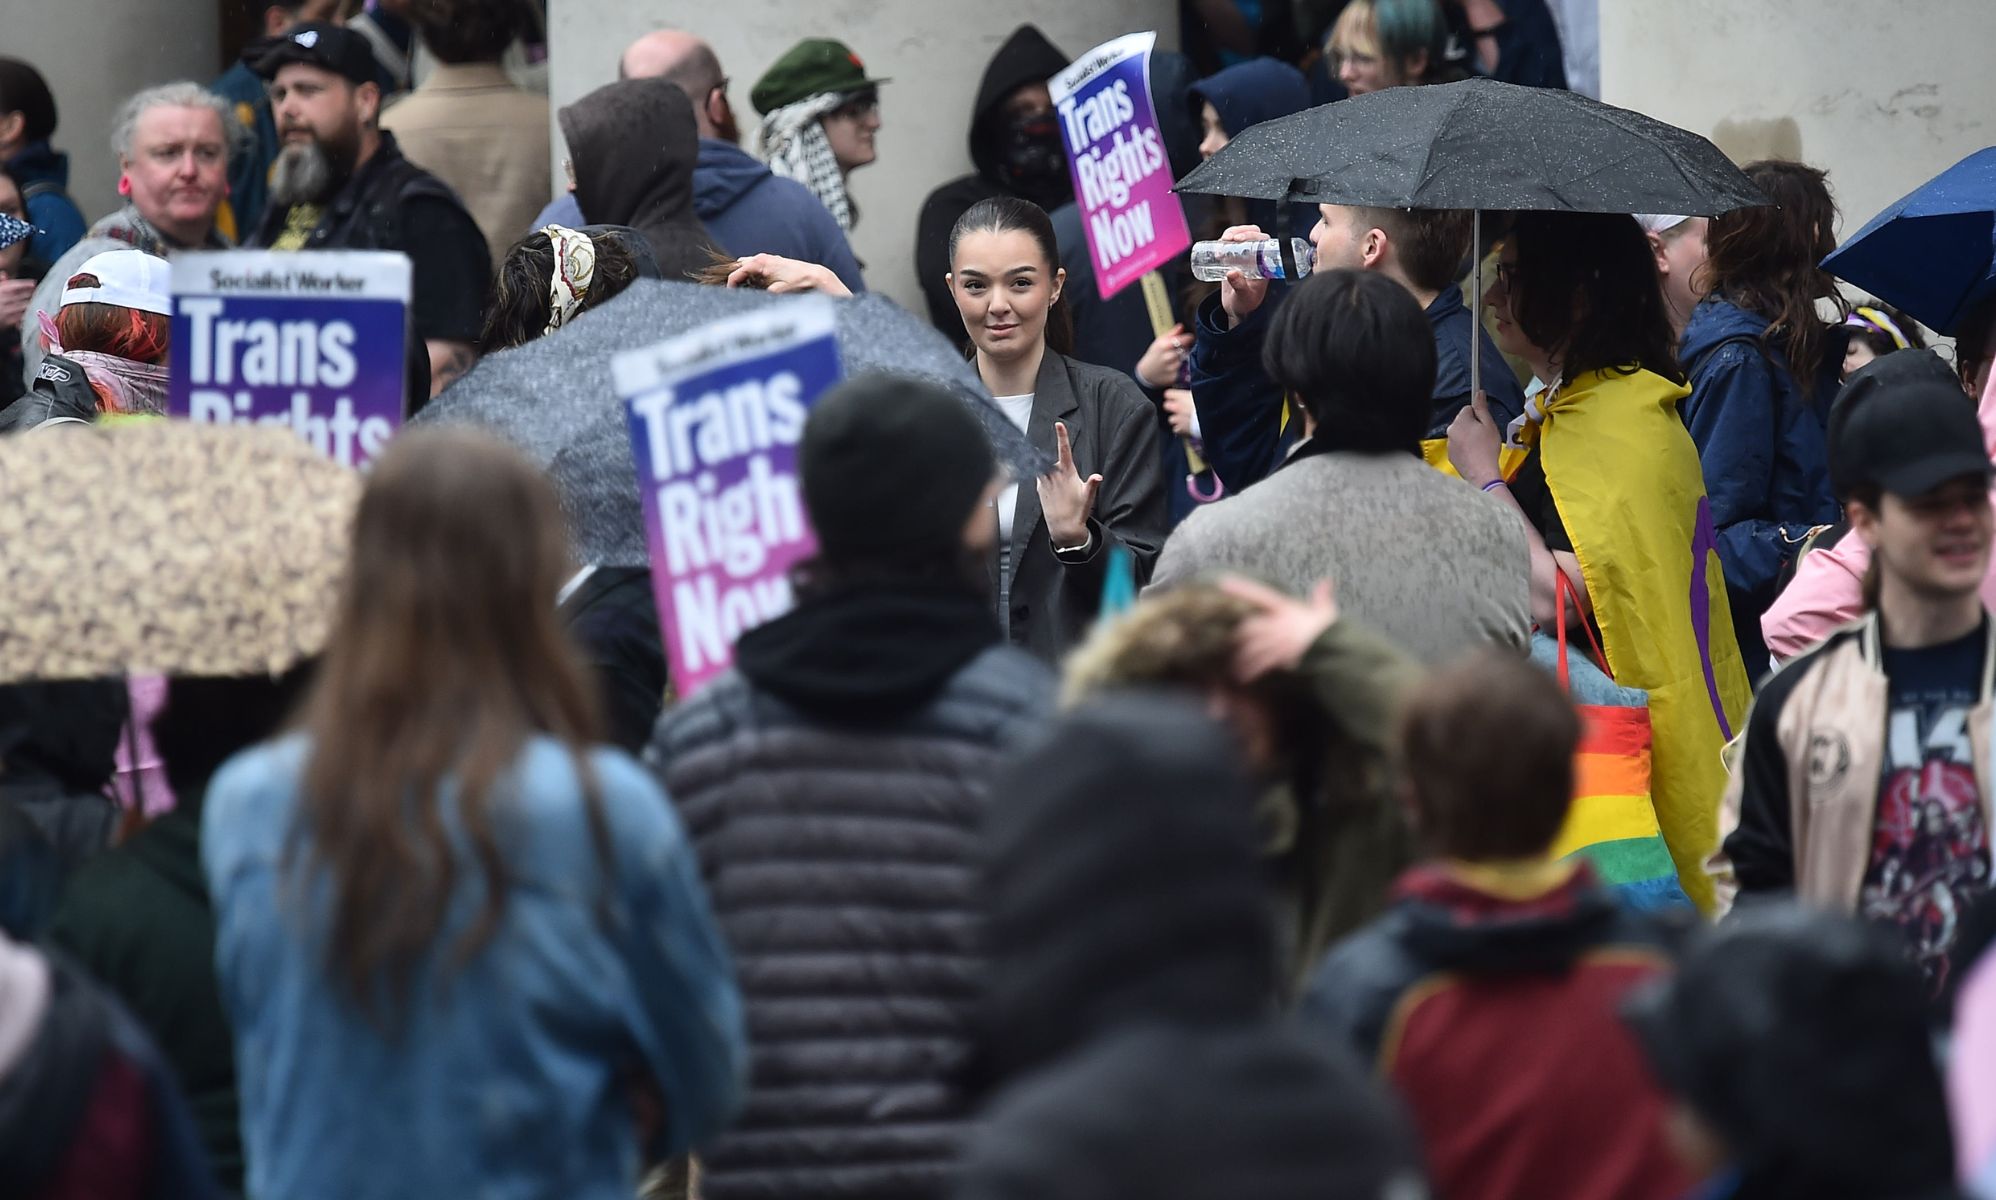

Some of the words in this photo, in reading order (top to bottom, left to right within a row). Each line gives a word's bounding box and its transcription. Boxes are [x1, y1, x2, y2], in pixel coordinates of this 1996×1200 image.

[1058, 78, 1135, 155] Trans
[1075, 123, 1164, 212] Rights
[1090, 199, 1156, 272] Now
[178, 297, 358, 388] Trans
[631, 371, 808, 482] Trans
[657, 453, 803, 578] Righ
